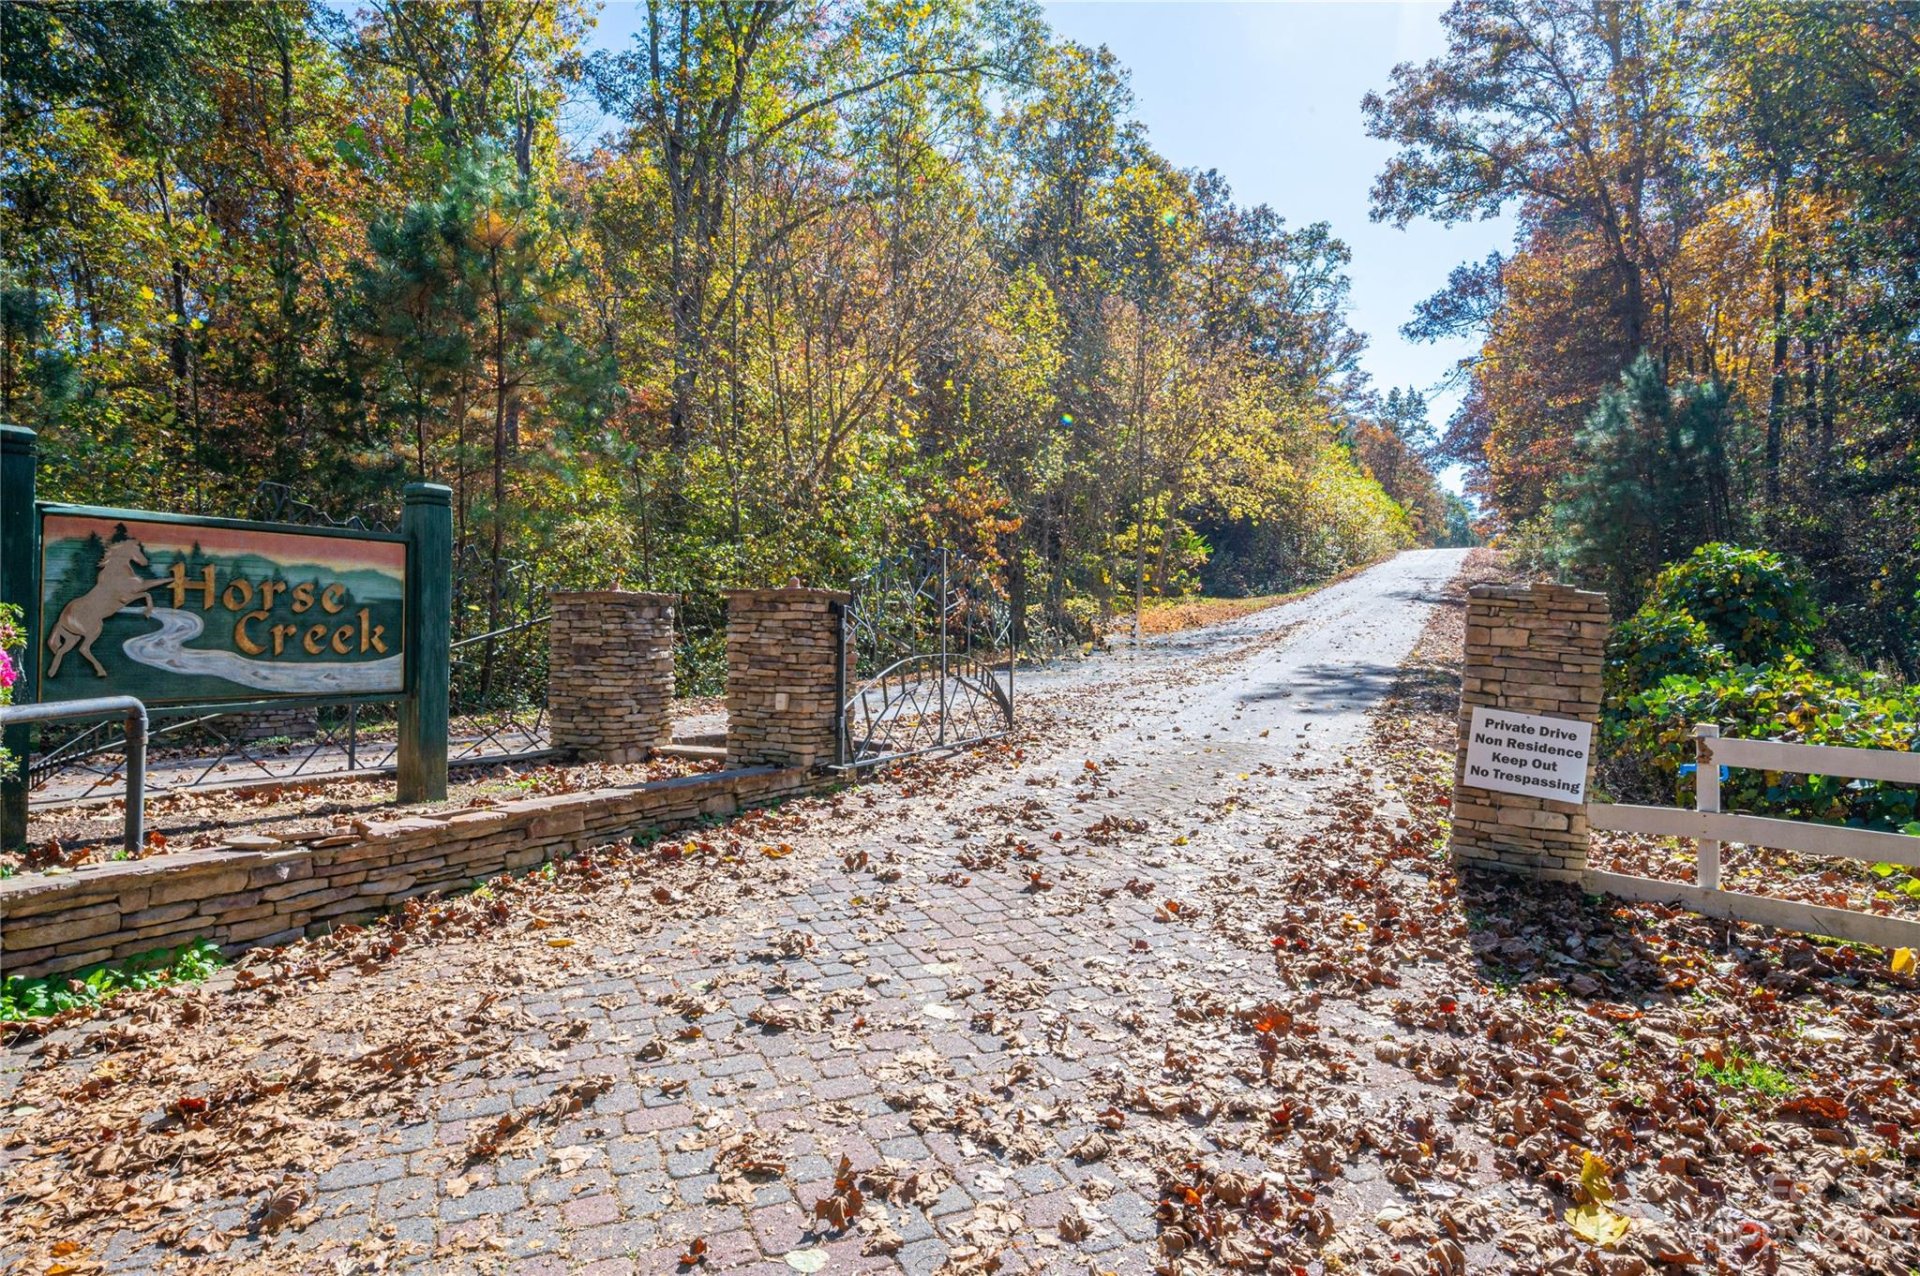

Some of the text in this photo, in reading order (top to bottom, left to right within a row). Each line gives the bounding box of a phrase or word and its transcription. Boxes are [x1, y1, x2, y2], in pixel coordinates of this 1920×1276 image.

[167, 561, 345, 614] Horse
[234, 607, 389, 656] Creek
[1485, 718, 1577, 741] Private Drive
[1475, 733, 1583, 759] Non Residence
[1492, 752, 1558, 772] Keep Out
[1470, 765, 1581, 795] No Trespassing
